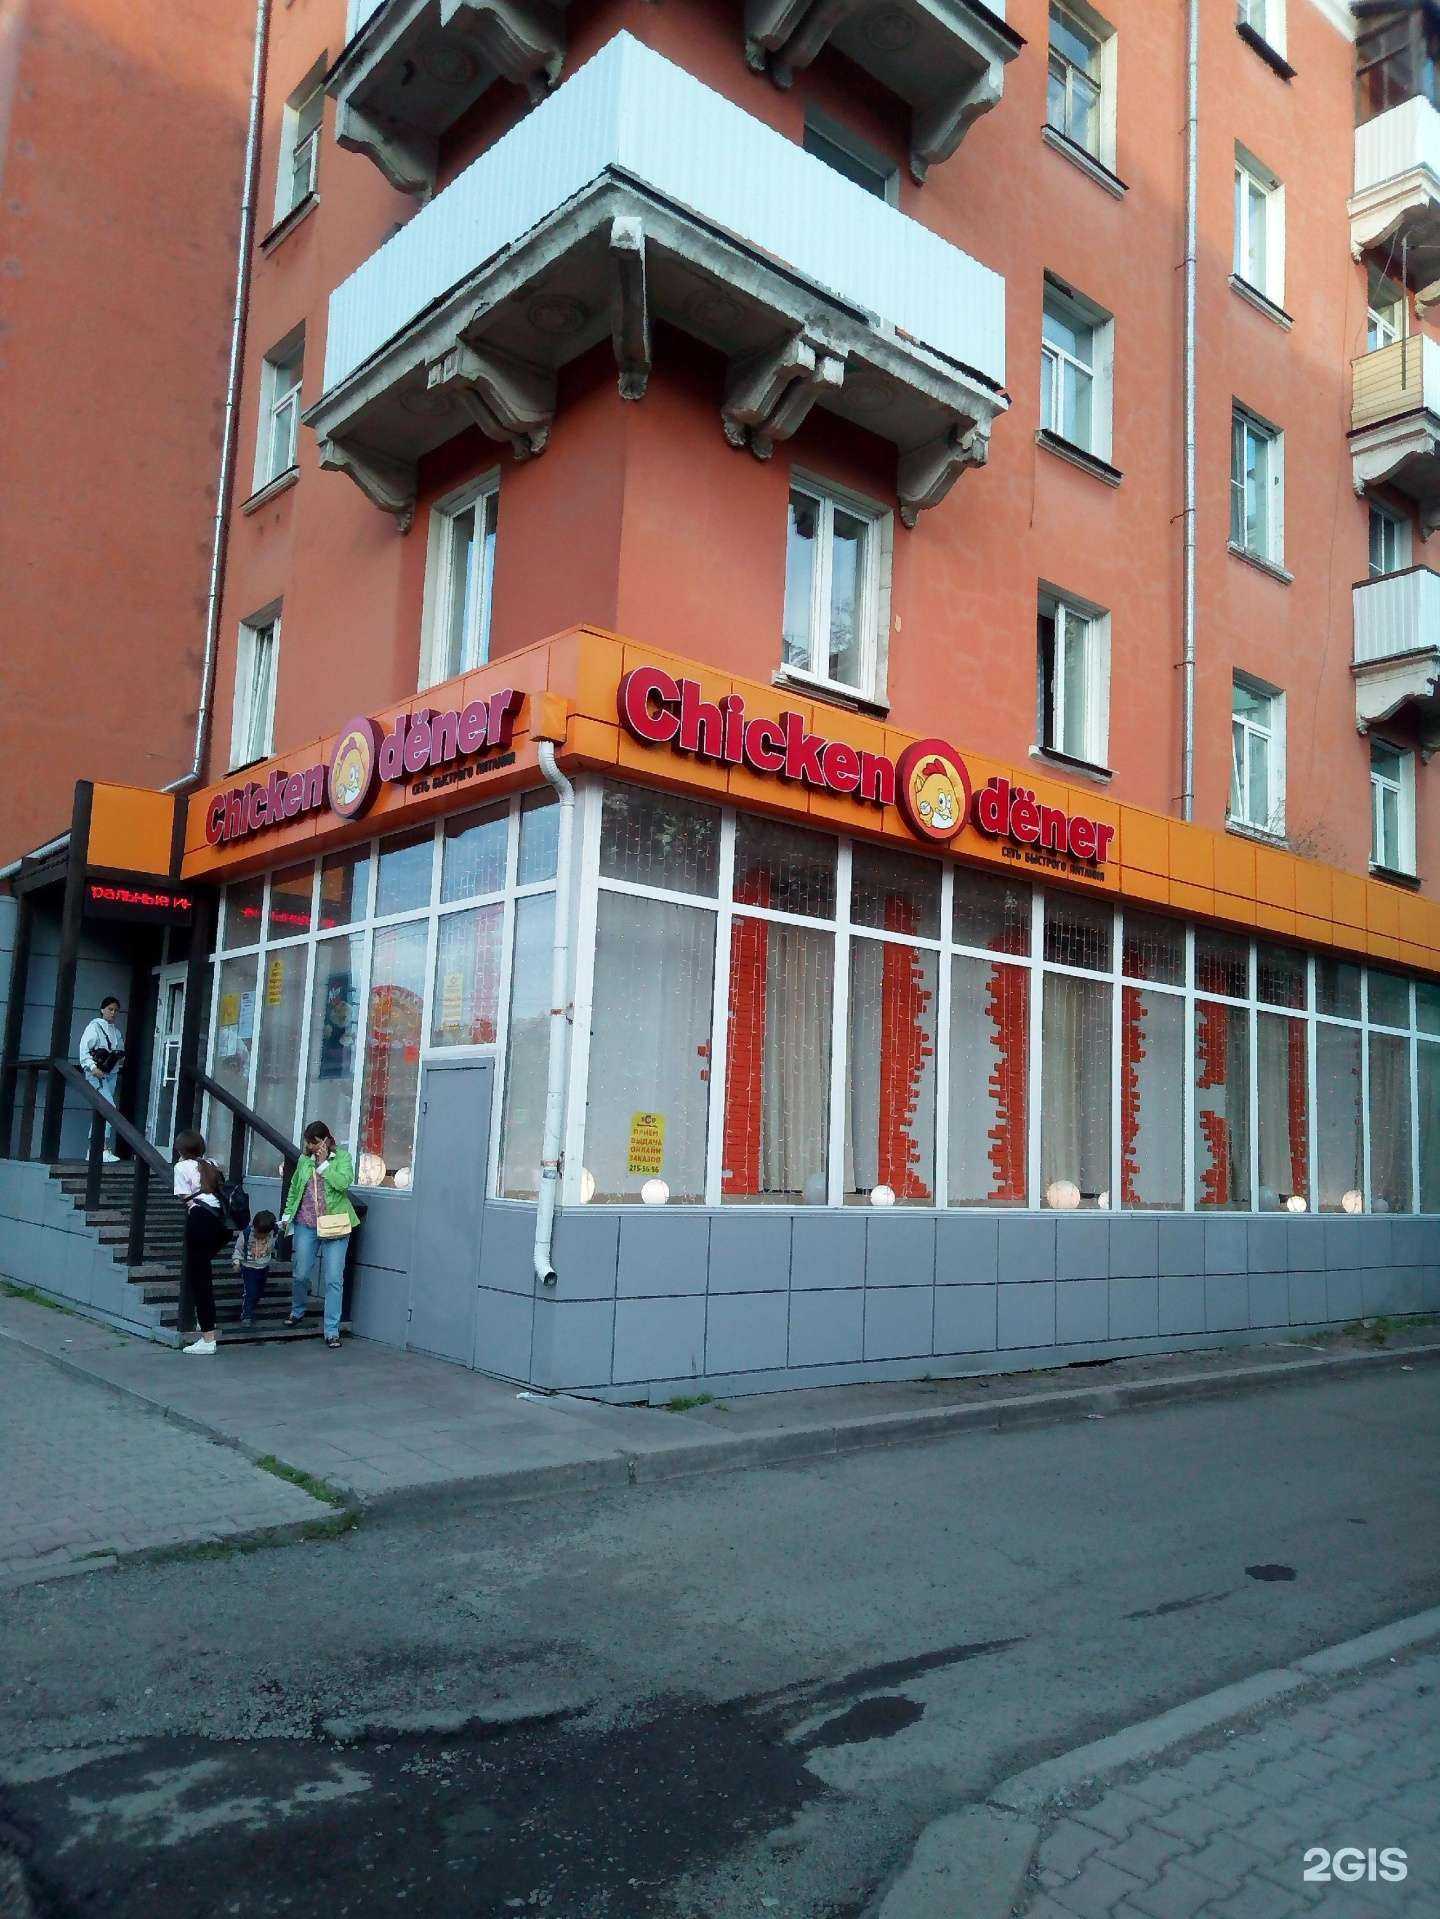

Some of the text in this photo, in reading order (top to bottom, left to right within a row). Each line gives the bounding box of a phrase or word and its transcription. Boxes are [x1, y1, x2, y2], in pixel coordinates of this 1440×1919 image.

[205, 688, 522, 847] Chicken dëner
[412, 780, 430, 796] СЕТЬ
[618, 665, 1115, 865] Chicken dëner
[1002, 846, 1022, 861] СЕТЬ
[1025, 852, 1067, 872] БЫСТРОГО
